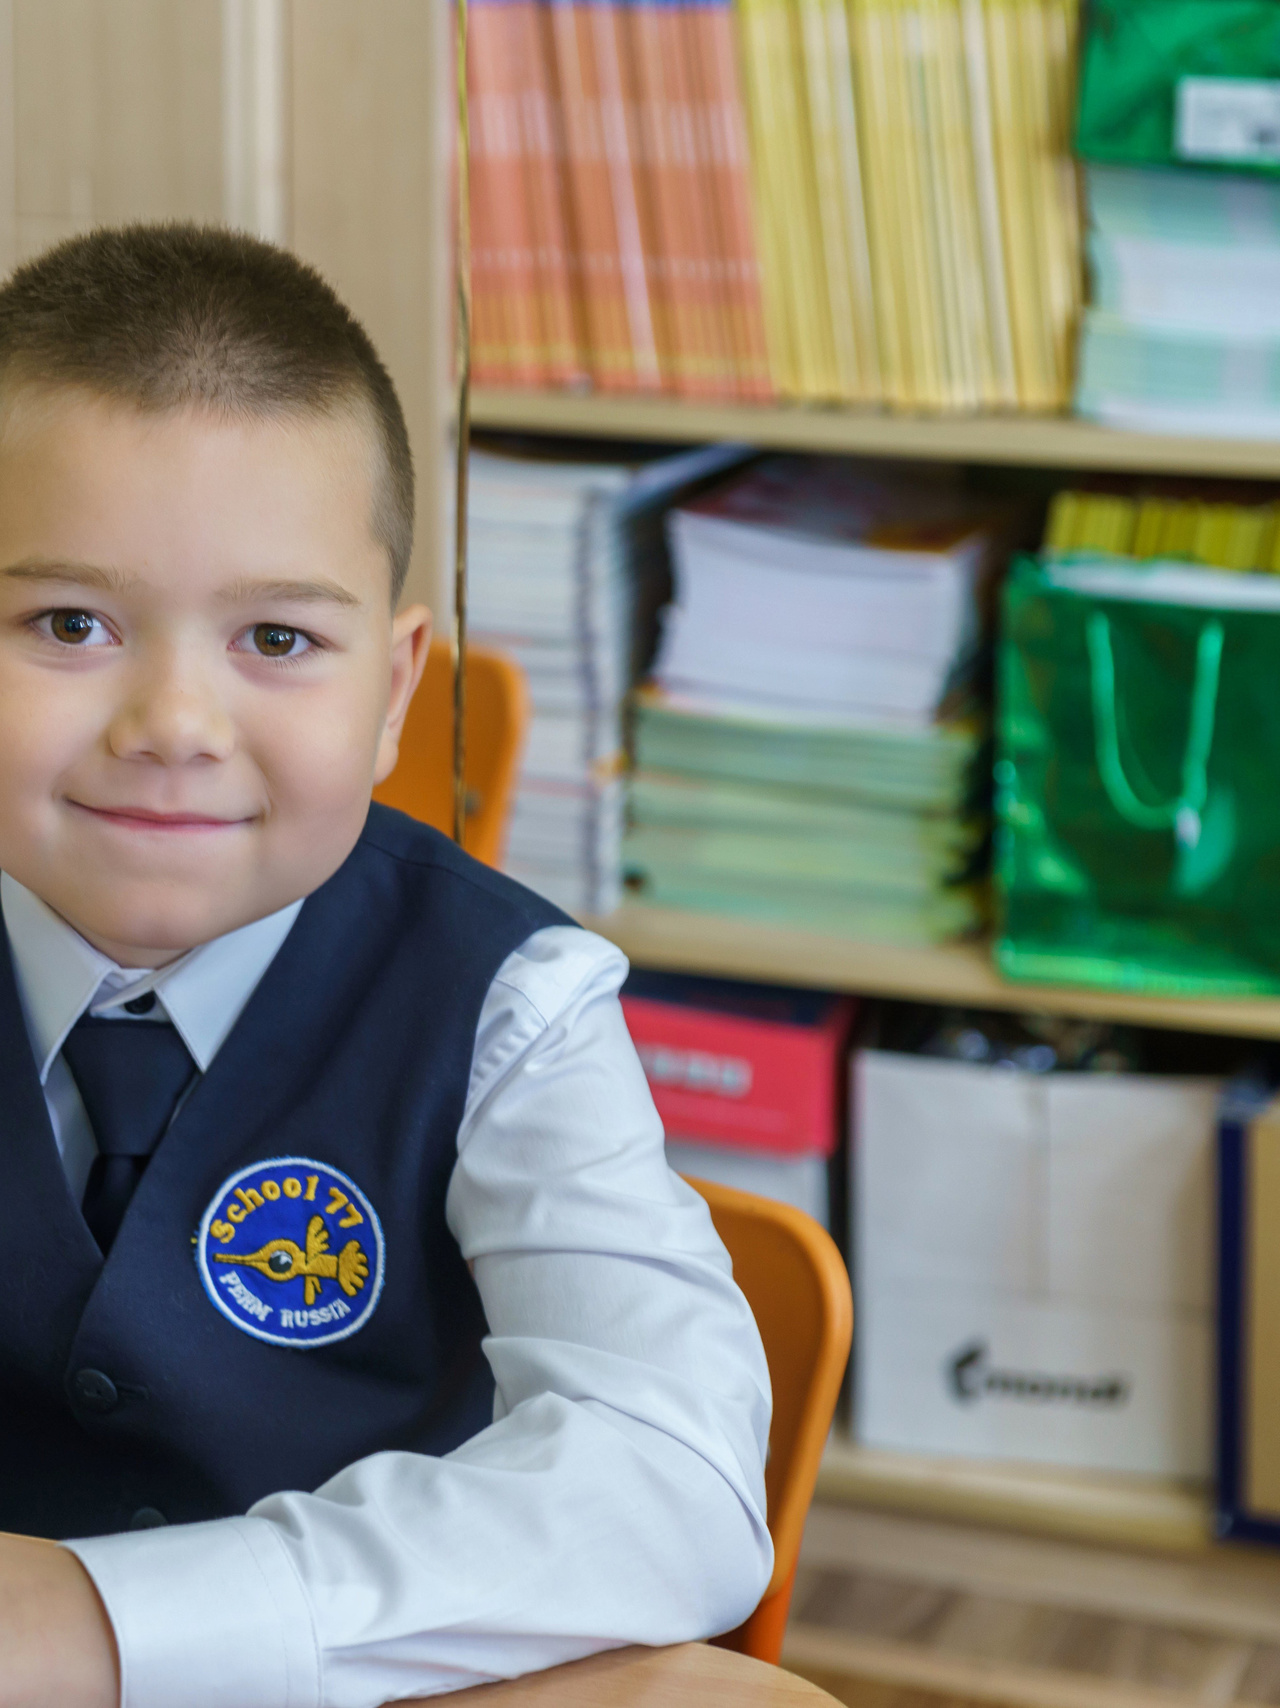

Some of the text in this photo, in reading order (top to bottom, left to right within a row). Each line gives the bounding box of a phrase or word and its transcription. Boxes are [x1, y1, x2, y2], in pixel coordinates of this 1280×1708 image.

[209, 1174, 364, 1244] School 77
[218, 1270, 352, 1329] PERM RUSSIA
